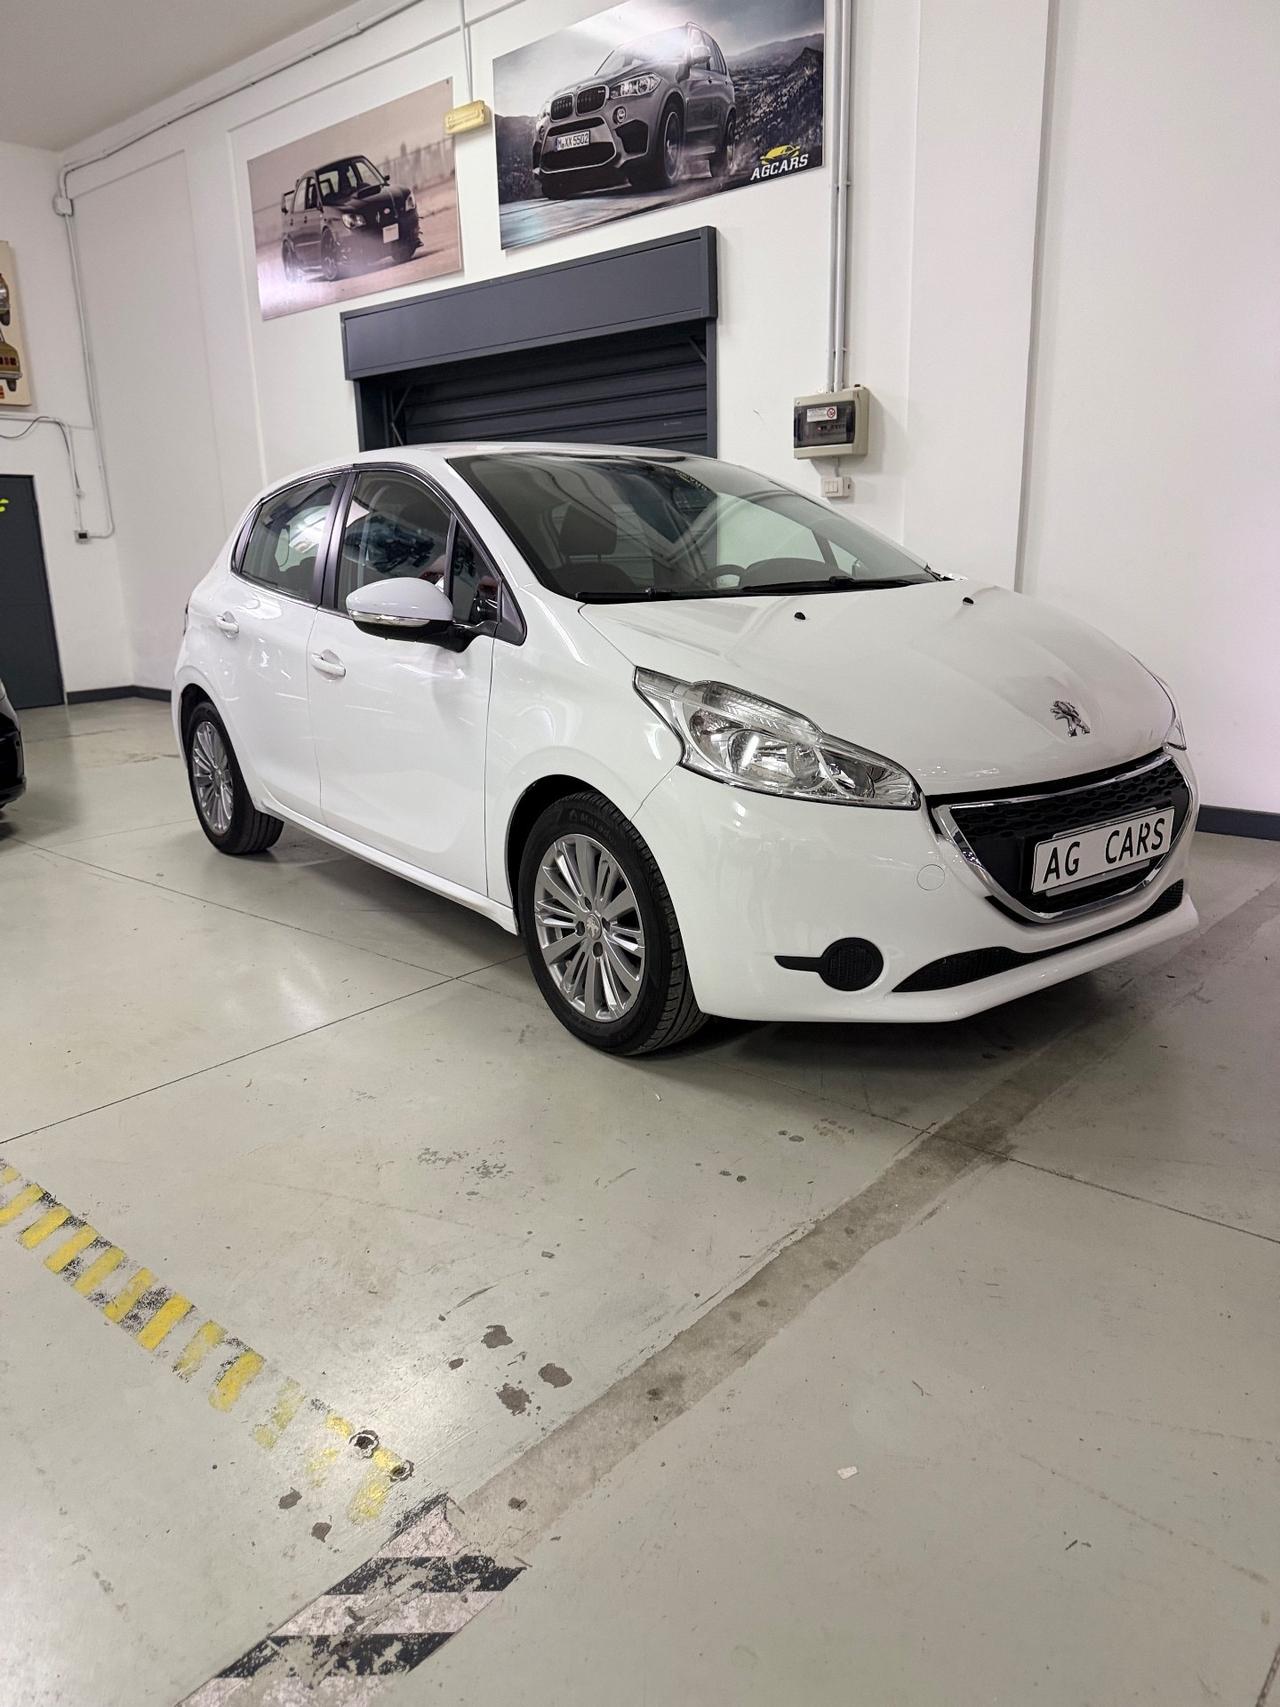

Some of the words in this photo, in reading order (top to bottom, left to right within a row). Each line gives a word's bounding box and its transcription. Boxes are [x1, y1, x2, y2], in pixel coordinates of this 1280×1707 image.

[750, 153, 809, 181] AGCARS
[1043, 841, 1081, 884] AG
[1105, 817, 1165, 864] CARS
